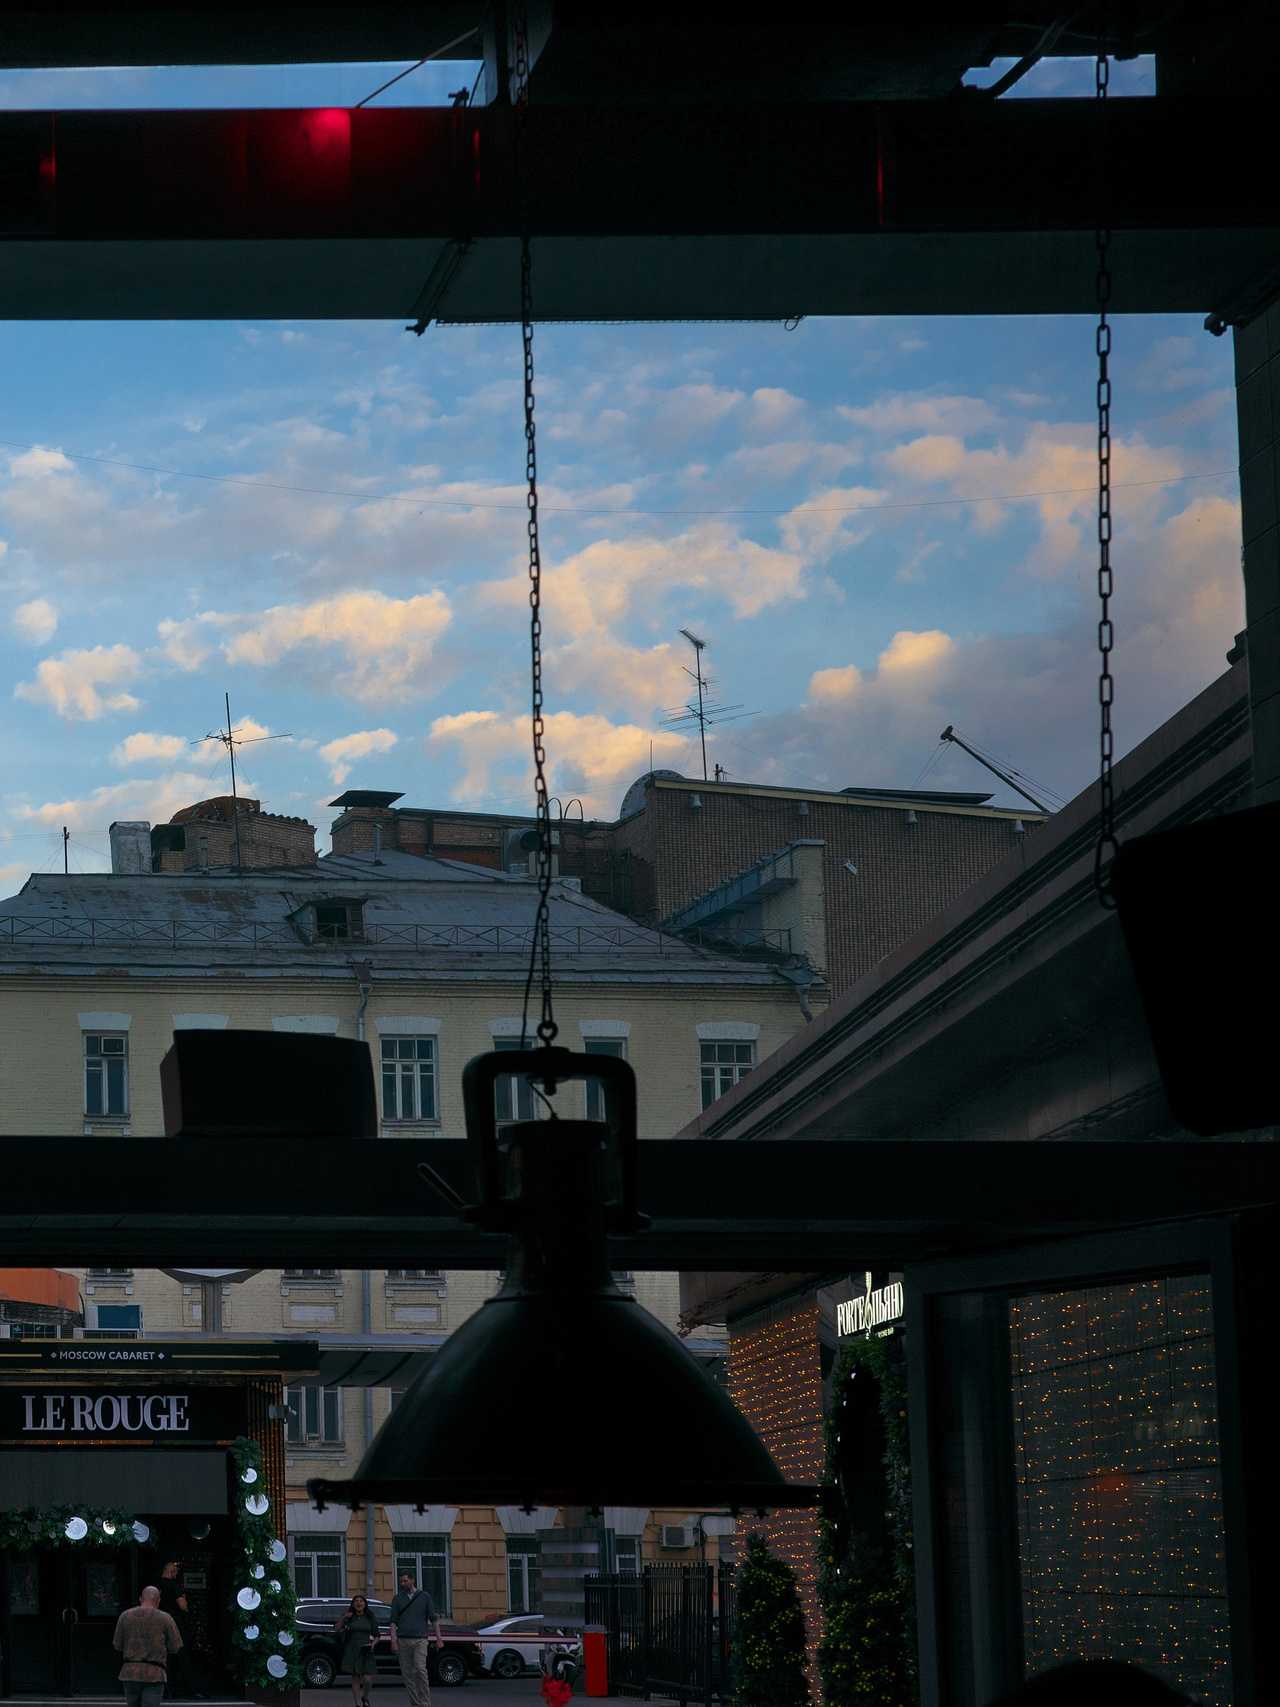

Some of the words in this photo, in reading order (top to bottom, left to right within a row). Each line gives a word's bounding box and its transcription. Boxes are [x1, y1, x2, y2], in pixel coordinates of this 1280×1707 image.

[59, 1351, 106, 1360] MOSCOW
[108, 1351, 155, 1360] CABARET
[22, 1395, 65, 1431] LE
[70, 1395, 189, 1431] ROUGE
